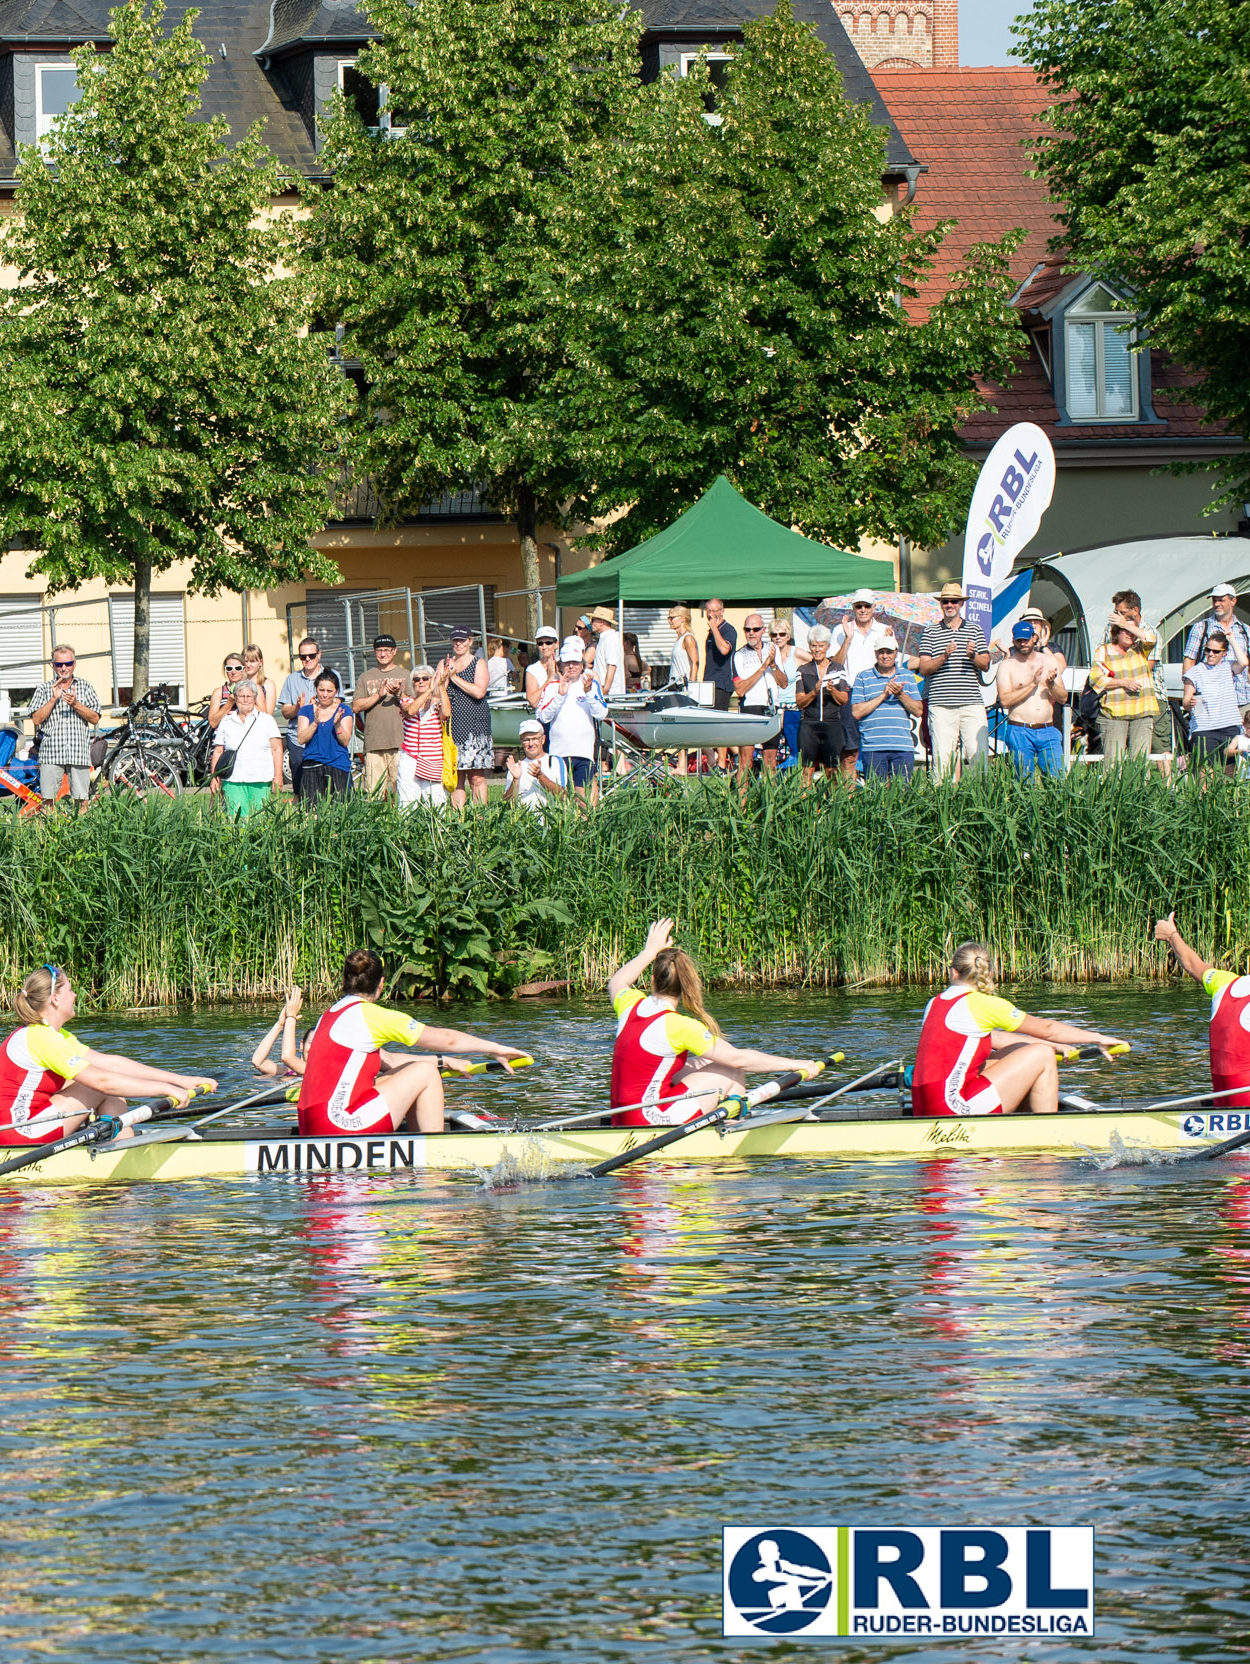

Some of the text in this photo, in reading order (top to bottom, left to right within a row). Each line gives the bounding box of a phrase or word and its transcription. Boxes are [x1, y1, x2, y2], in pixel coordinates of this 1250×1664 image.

[987, 448, 1038, 530] RBL
[919, 1120, 971, 1145] Melitta
[257, 1140, 414, 1171] MINDEN
